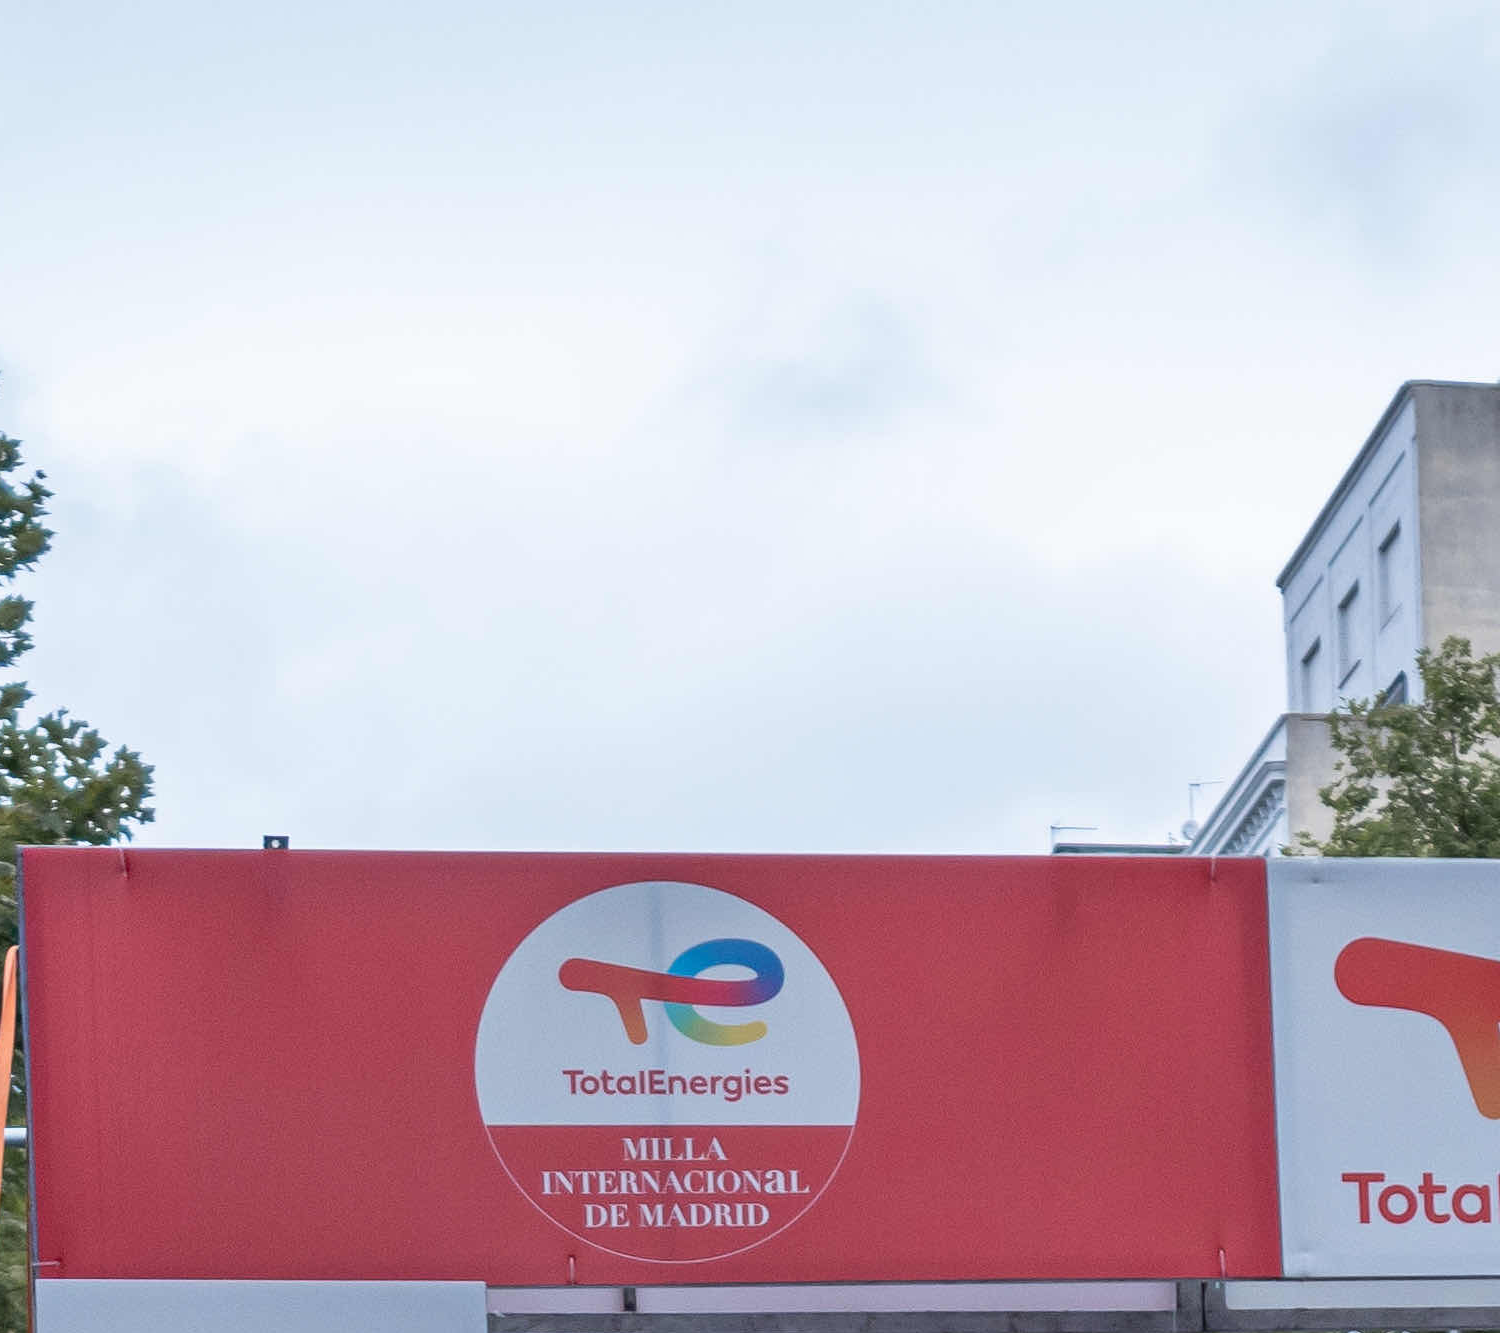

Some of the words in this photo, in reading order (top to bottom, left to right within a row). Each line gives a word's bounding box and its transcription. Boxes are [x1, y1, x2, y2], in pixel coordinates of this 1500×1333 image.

[561, 1066, 791, 1104] TotalEnergies
[622, 1136, 729, 1163] MILLA
[583, 1203, 632, 1230] DE
[637, 1202, 772, 1231] MADRID
